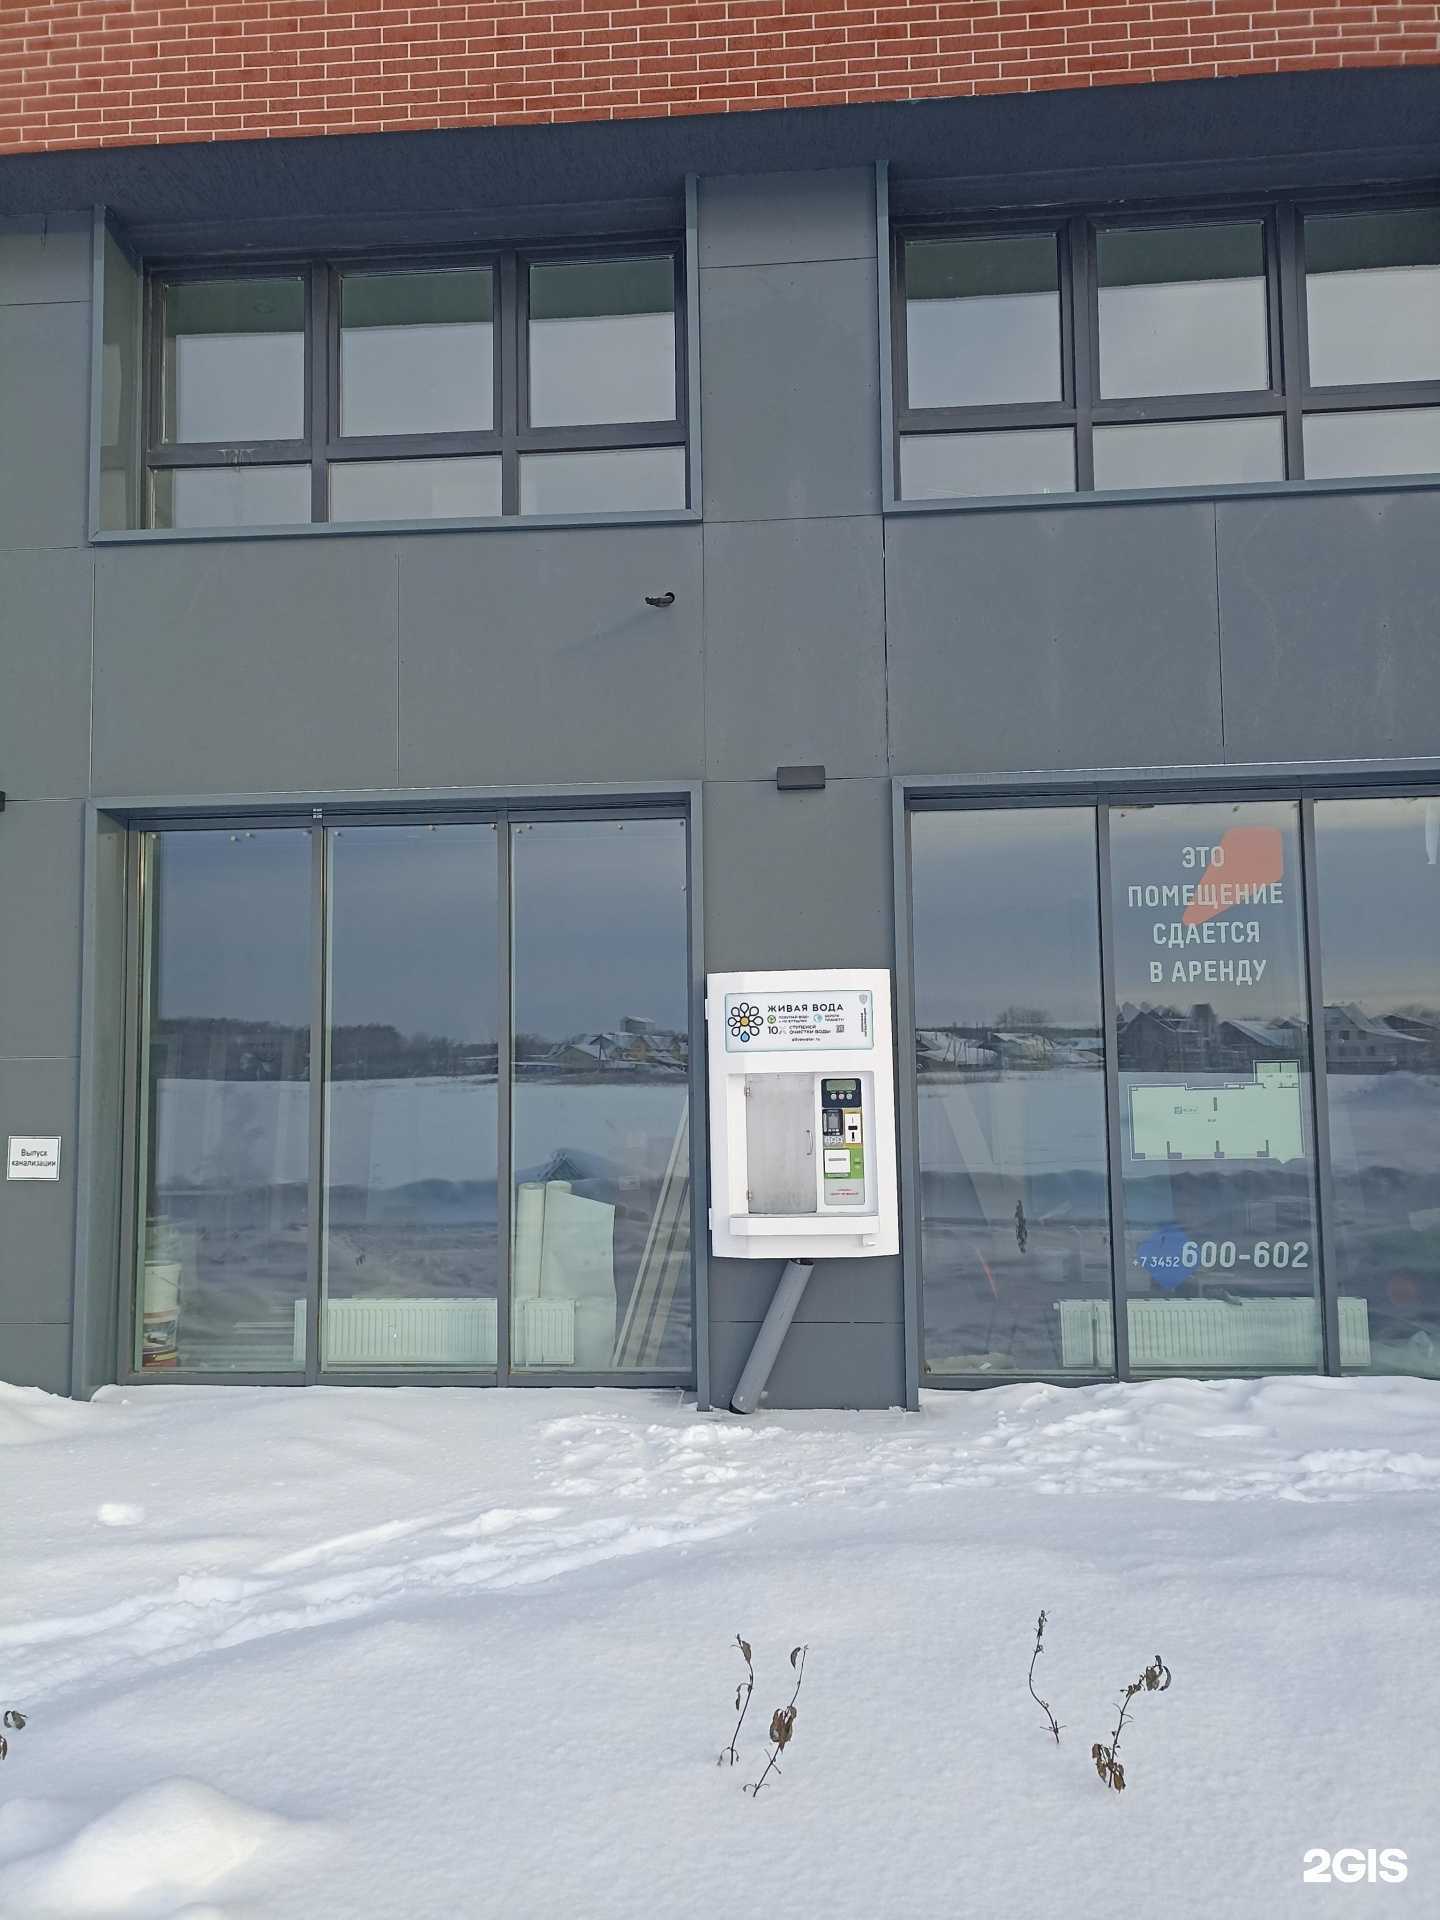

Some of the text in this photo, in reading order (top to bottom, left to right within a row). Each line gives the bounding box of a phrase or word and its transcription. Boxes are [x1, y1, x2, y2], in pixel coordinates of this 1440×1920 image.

[1182, 846, 1225, 868] ЭТО
[1128, 882, 1284, 909] ПОМЕЩЕНИЕ
[1153, 921, 1260, 948] СДАЕТСЯ
[1150, 959, 1267, 986] В АРЕНДУ
[767, 1003, 844, 1013] ЖИВАЯ ВОДА
[767, 1026, 779, 1035] 10
[20, 1148, 48, 1157] Выпуск
[1132, 1240, 1309, 1268] +7 3452 600-602
